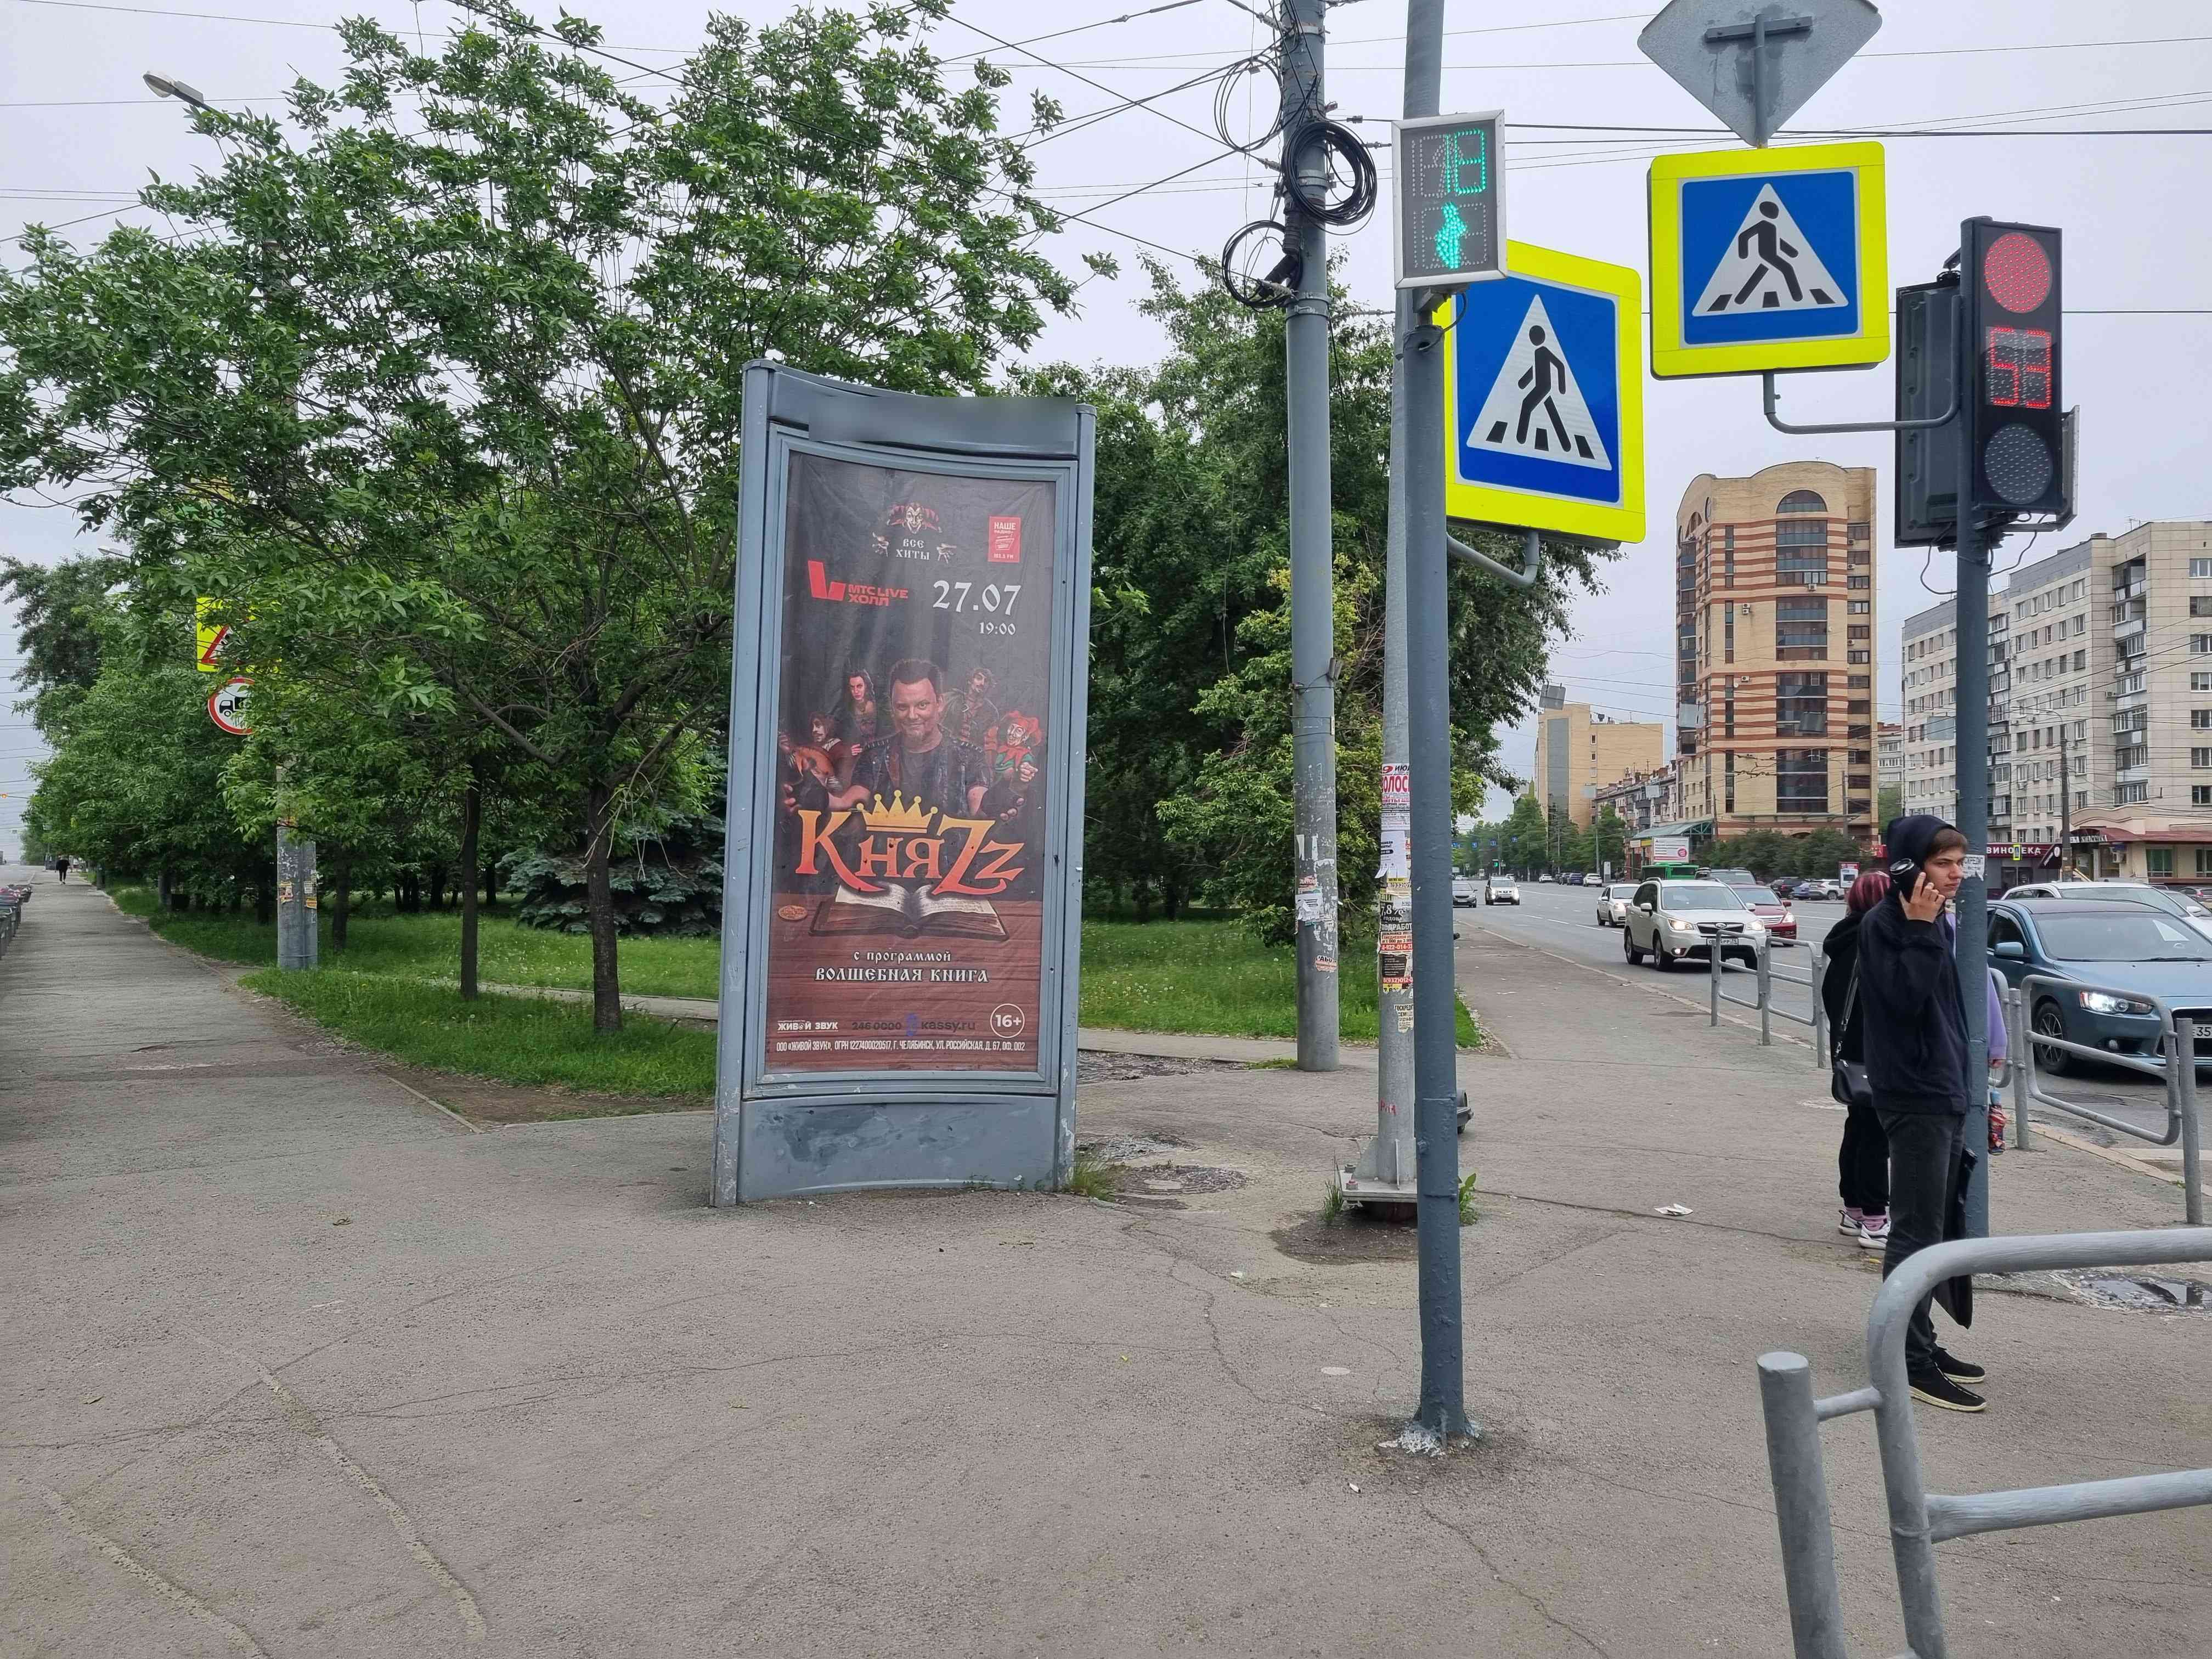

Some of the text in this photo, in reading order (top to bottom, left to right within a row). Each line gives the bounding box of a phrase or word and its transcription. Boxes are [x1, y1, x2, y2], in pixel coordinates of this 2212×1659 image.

[1445, 127, 1487, 194] 18
[1990, 326, 2052, 409] 53
[994, 522, 1017, 531] НАШЕ
[902, 538, 926, 549] ВСЕ
[895, 549, 930, 560] ХИТЫ
[848, 584, 909, 599] МТС LIVE
[933, 580, 1022, 616] 27.07
[848, 593, 889, 606] ХОЛЛ
[979, 622, 1017, 635] 19:00
[1381, 776, 1409, 792] ОЛОС
[1986, 846, 2041, 855] ВИНОЕКА
[853, 950, 952, 964] с программой
[815, 967, 989, 983] ВОЛШЕБНАЯ КНИГА
[815, 1022, 839, 1030] ЗВУК
[921, 1020, 976, 1033] kassy.ru
[995, 1014, 1022, 1028] 16+
[2192, 1026, 2211, 1037] 35
[776, 1042, 787, 1052] ООО
[834, 1041, 849, 1050] ОГРН
[900, 1040, 935, 1051] ЧЕЛЯБИНСК,
[936, 1041, 945, 1050] УЛ.
[1014, 1042, 1025, 1051] 002
